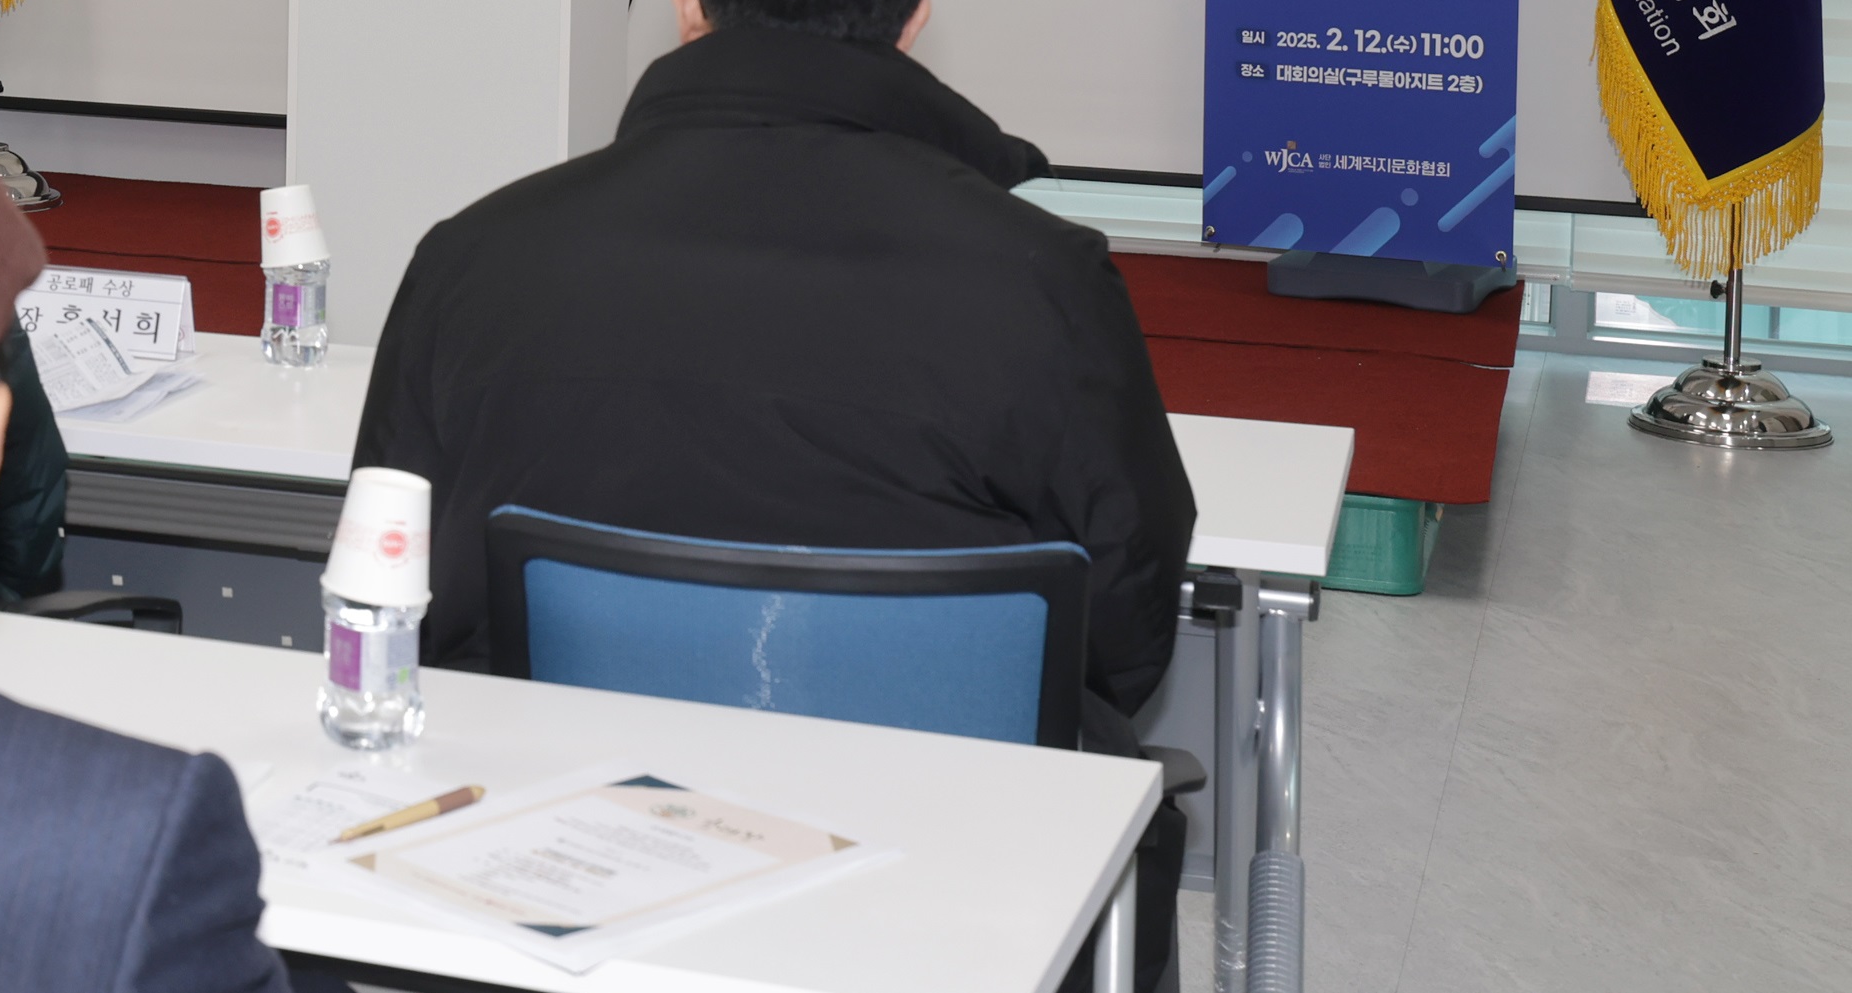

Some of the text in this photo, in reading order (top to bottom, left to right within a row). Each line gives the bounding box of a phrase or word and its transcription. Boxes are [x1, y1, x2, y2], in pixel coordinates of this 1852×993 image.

[1241, 30, 1265, 45] 일시
[1276, 31, 1321, 49] 2025.
[1421, 32, 1485, 59] 11:00
[1240, 63, 1265, 78] 장소
[1447, 74, 1483, 94] 2층)
[1264, 148, 1314, 173] WJCA
[1334, 155, 1450, 178] 세계직지문화협회
[47, 274, 134, 298] 공로패 수상
